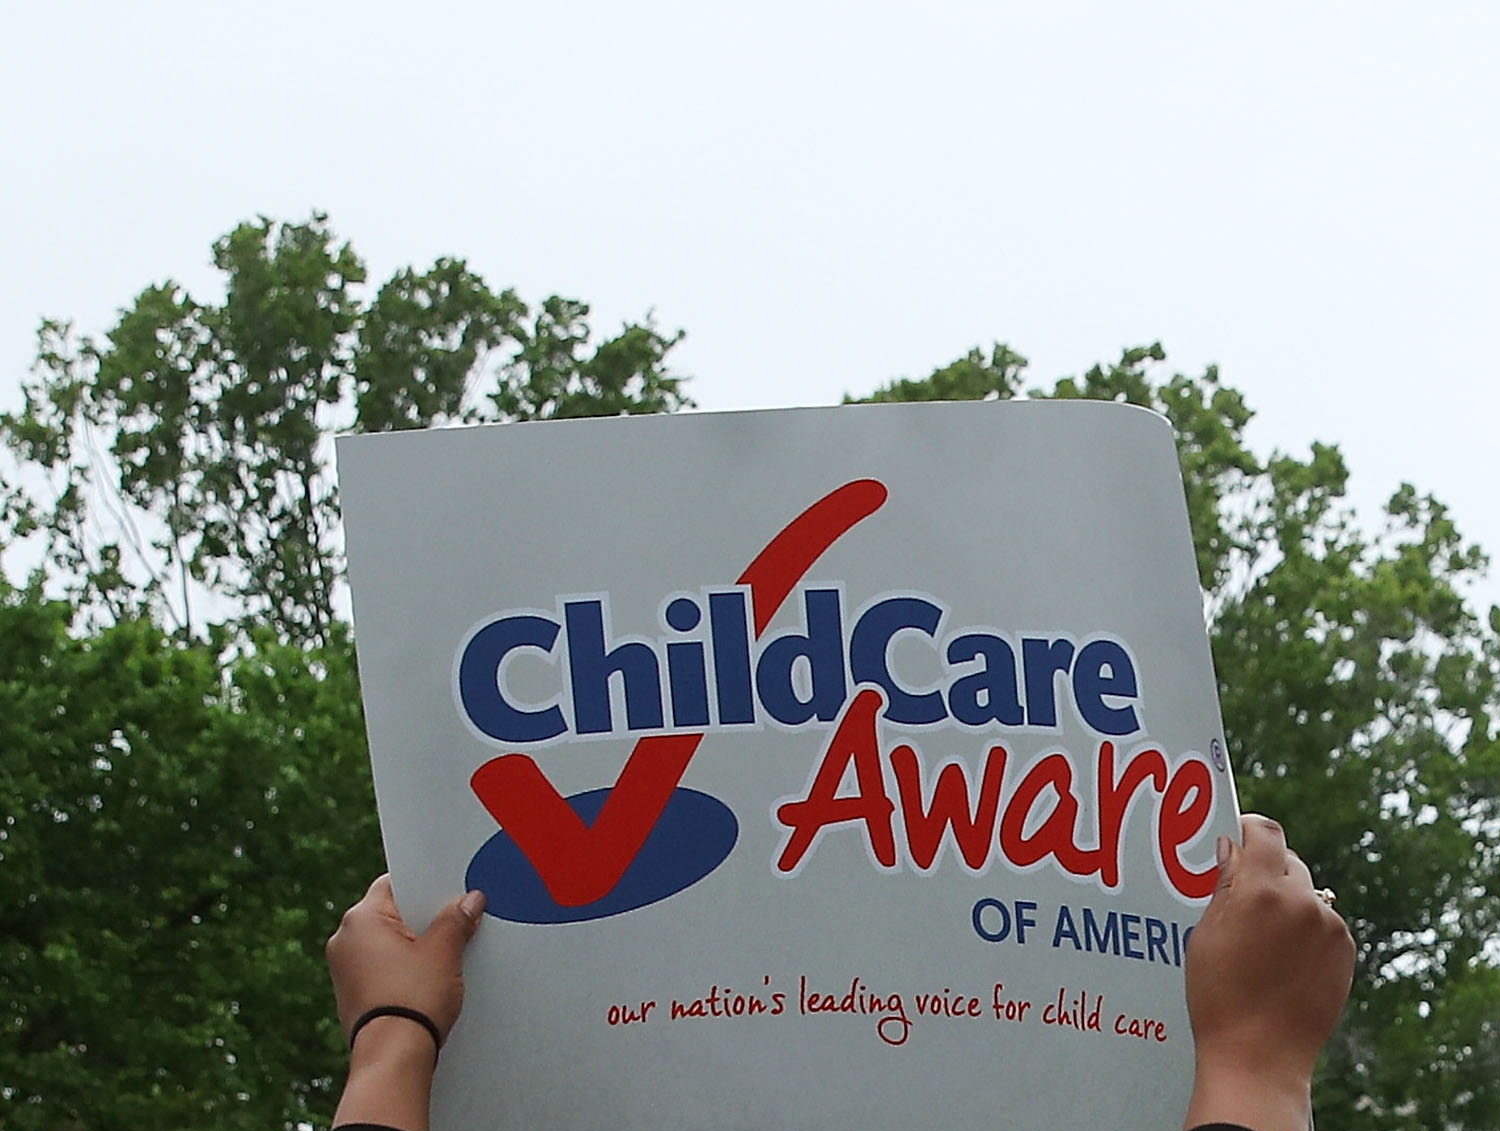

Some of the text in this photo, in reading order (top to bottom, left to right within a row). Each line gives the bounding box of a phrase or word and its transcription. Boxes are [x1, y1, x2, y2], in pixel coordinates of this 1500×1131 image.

[457, 587, 1142, 744] ChildCare
[971, 897, 1195, 967] OF AMERI
[606, 975, 1168, 1046] our nation's leading voice for child care
